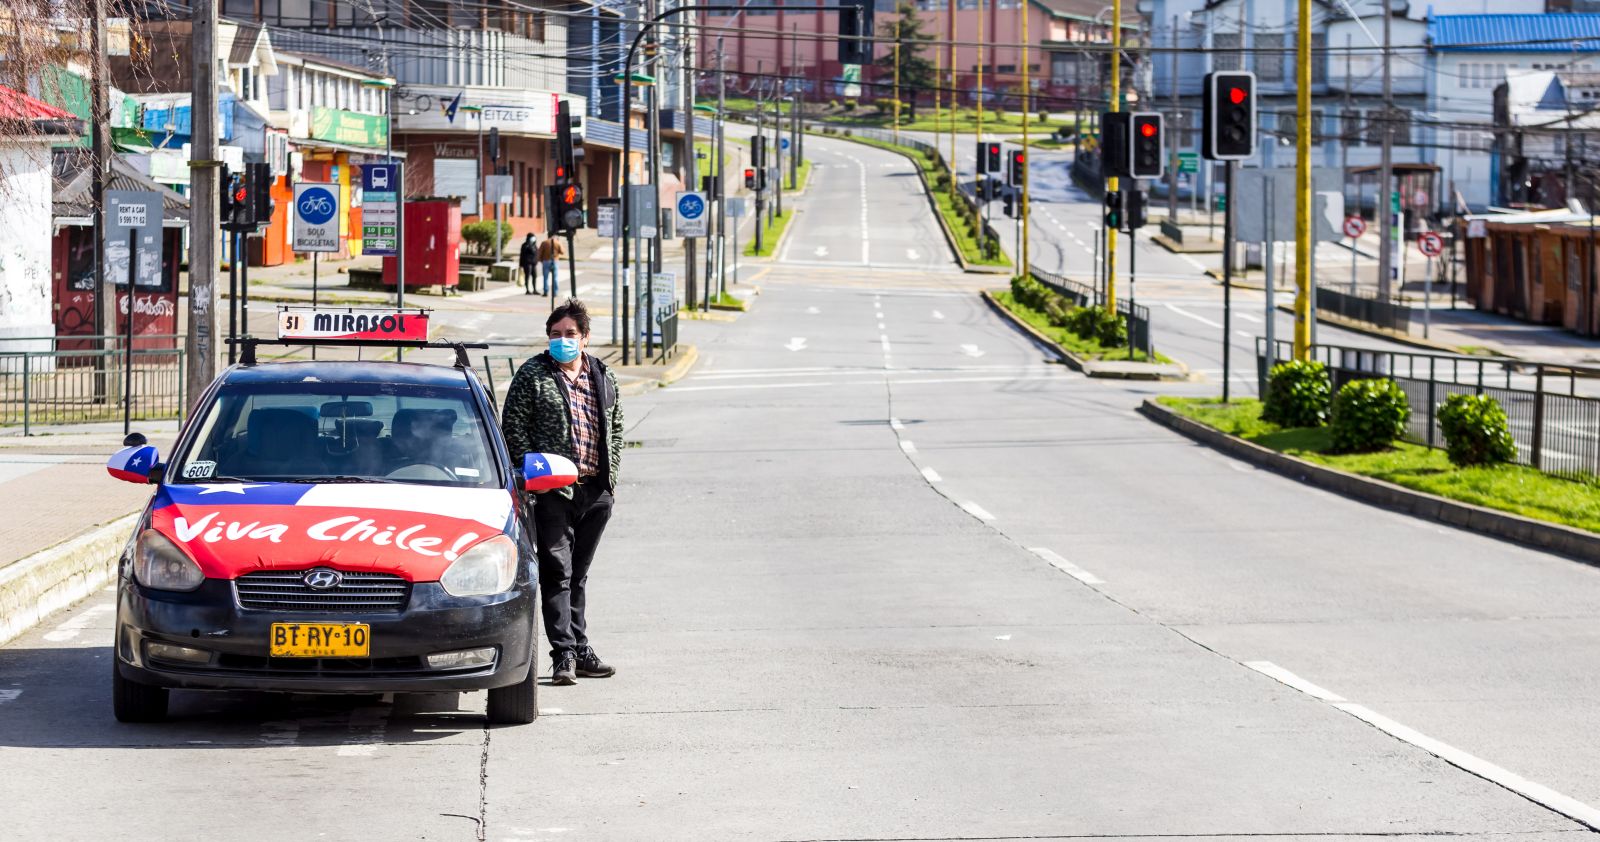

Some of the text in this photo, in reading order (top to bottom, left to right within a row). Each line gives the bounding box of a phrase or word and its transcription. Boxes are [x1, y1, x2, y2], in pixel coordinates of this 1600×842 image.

[119, 206, 131, 214] RENT
[136, 206, 145, 214] CAR
[307, 228, 325, 236] SOLO
[297, 238, 335, 247] BICICLETAS
[286, 313, 406, 333] 51 MIRASOL
[173, 511, 479, 561] Viva Chile!
